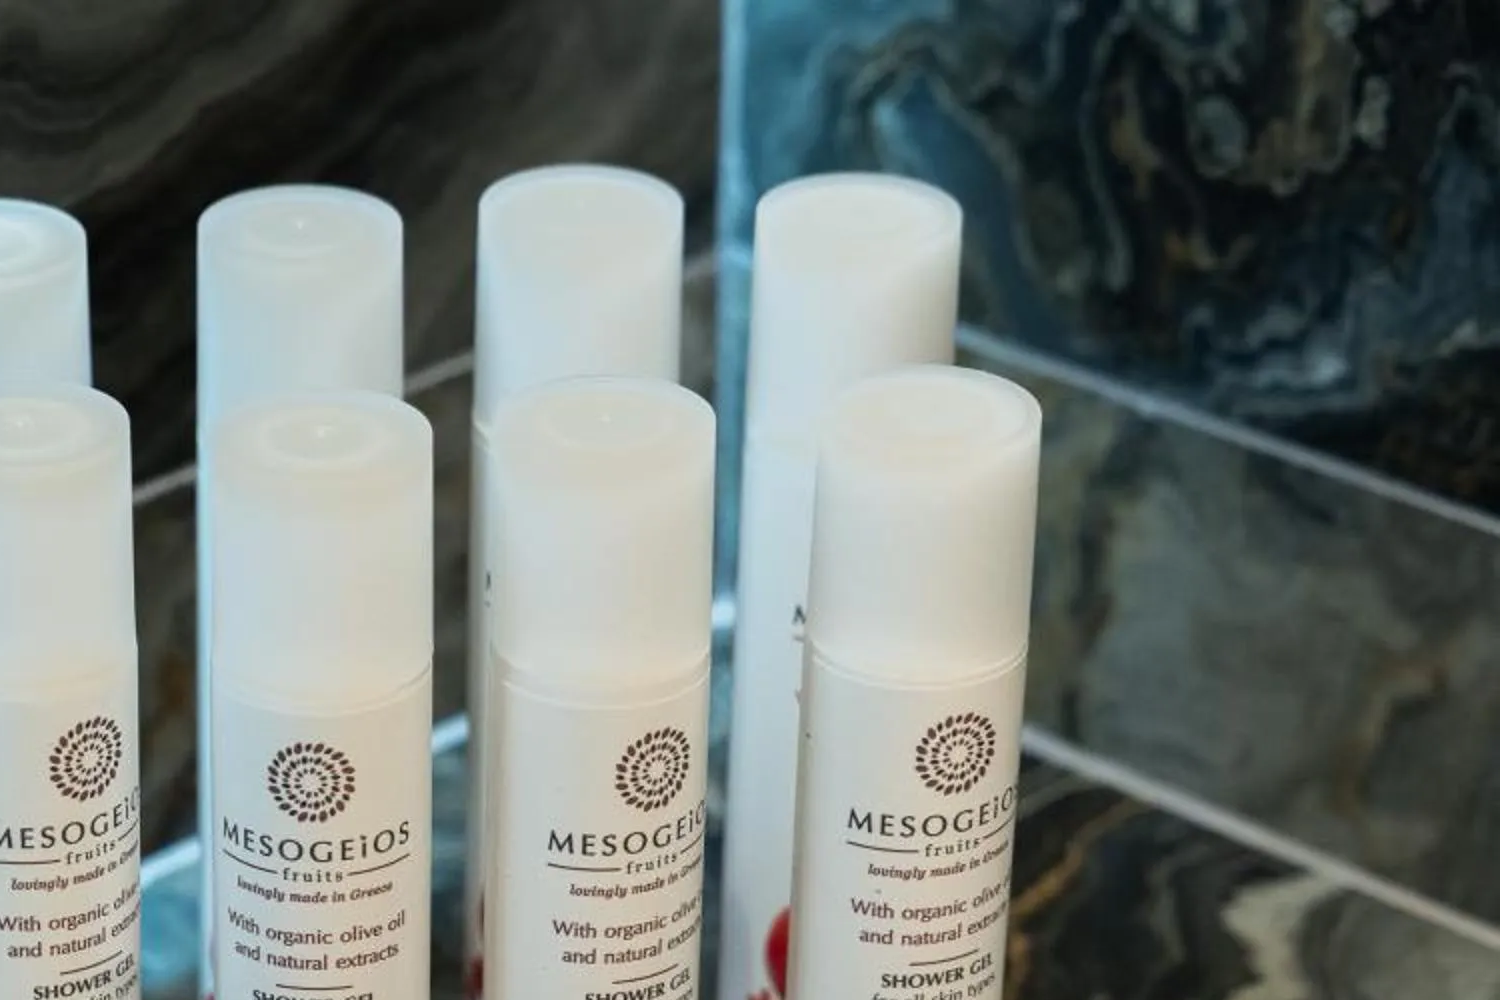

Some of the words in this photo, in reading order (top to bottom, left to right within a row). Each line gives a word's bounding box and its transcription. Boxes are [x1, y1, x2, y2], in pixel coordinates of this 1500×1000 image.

[223, 815, 410, 863] MESOGEiOS
[925, 837, 980, 857] fruits
[66, 840, 116, 865] fruits
[627, 853, 677, 875] fruits
[11, 876, 69, 892] lovingly
[283, 867, 343, 882] fruits
[868, 863, 926, 881] lovingly
[237, 874, 285, 902] lovingly
[289, 891, 328, 904] made
[332, 890, 346, 903] in
[350, 881, 393, 901] Greece
[569, 883, 628, 899] lovingly
[48, 903, 109, 931] organic
[851, 897, 894, 919] With
[902, 899, 967, 922] organic
[228, 905, 260, 936] With
[265, 926, 333, 947] organic
[340, 923, 383, 944] olive
[387, 909, 406, 931] oil
[552, 919, 597, 939] With
[604, 912, 668, 940] organic
[859, 930, 893, 945] and
[901, 922, 962, 946] natural
[7, 941, 43, 958] and
[49, 927, 106, 956] natural
[562, 948, 596, 965] and
[604, 938, 662, 964] natural
[235, 940, 261, 961] and
[267, 951, 328, 971] natural
[335, 943, 400, 970] extracts
[33, 968, 112, 1000] SHOWER
[881, 967, 964, 989] SHOWER
